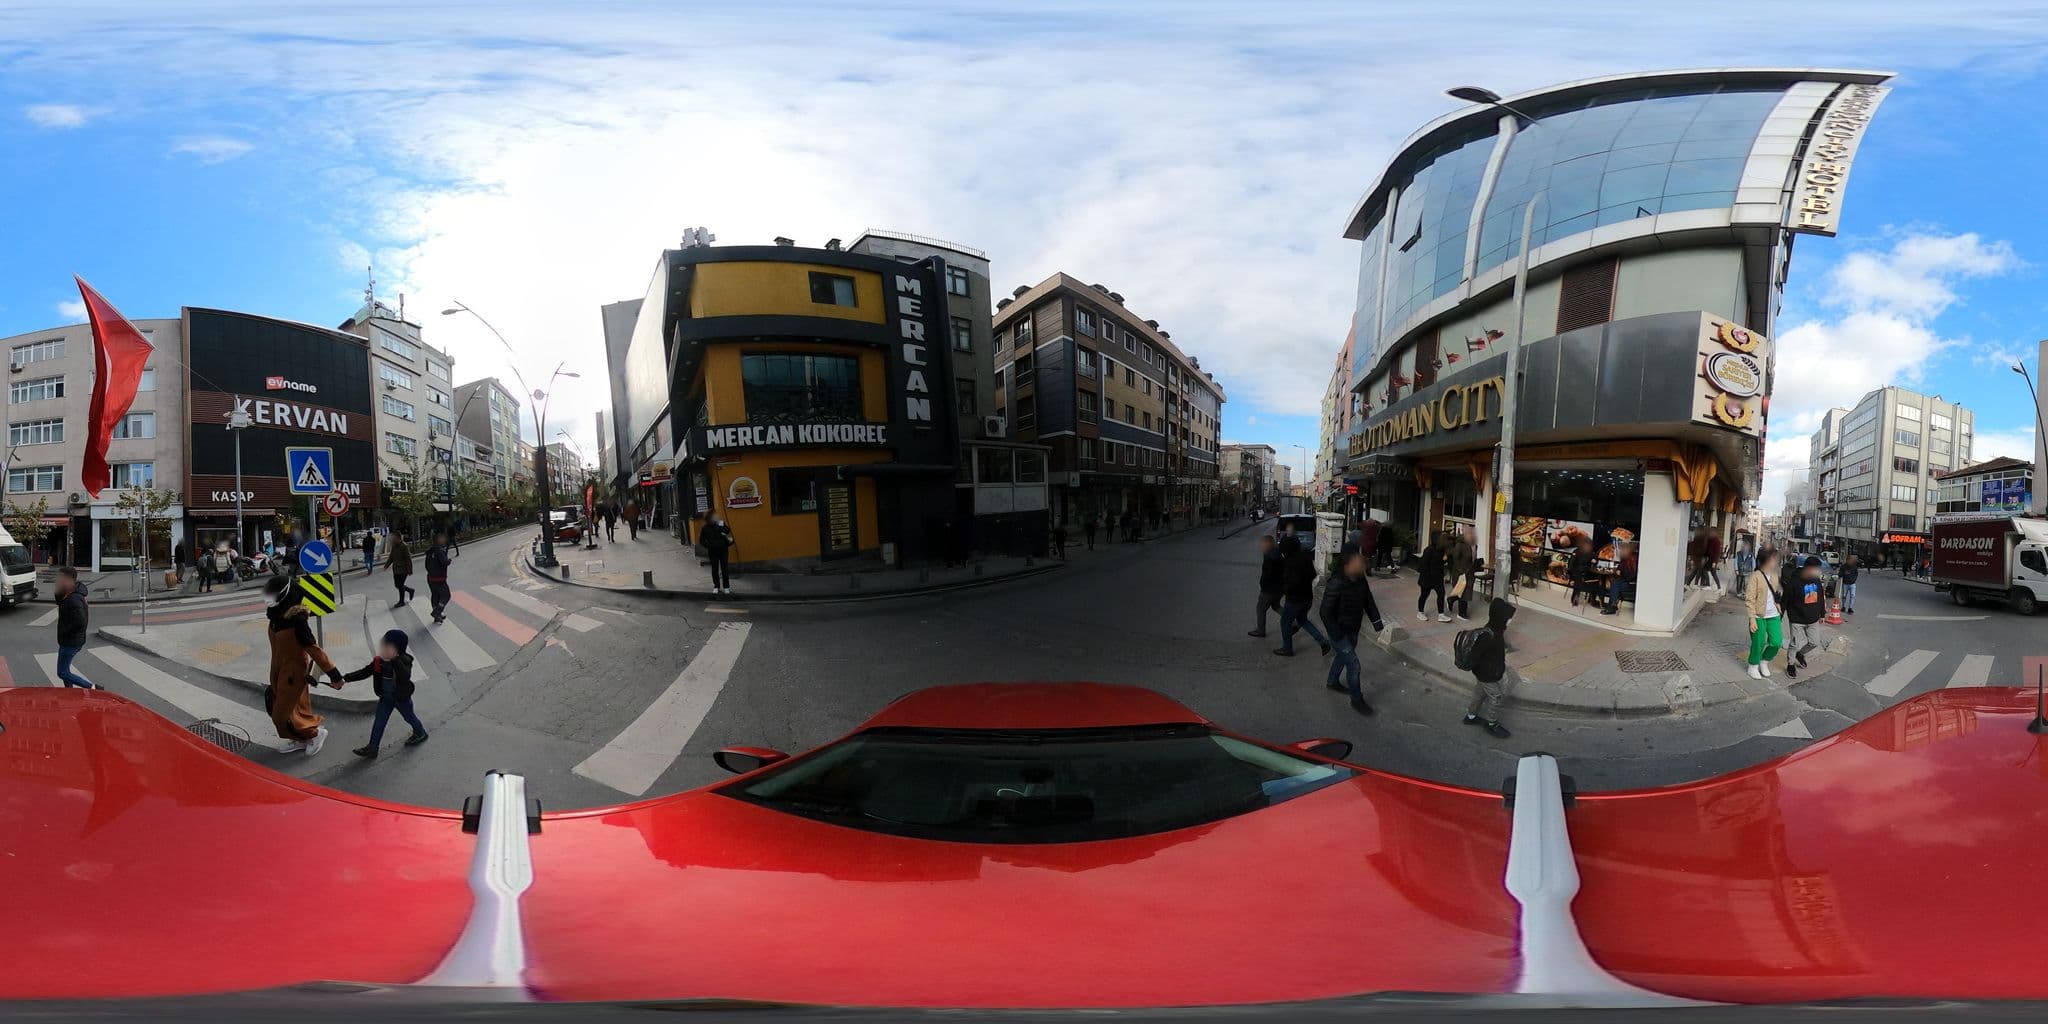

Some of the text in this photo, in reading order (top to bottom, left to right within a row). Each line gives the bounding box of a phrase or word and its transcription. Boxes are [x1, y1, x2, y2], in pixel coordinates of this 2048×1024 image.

[1798, 161, 1845, 229] HOTEL
[896, 274, 931, 422] MERCAN
[268, 377, 317, 394] evname
[234, 398, 348, 435] KERVAN
[1347, 432, 1364, 457] THE
[1363, 399, 1435, 452] OTTOMAN
[706, 424, 887, 449] MERCAN KOKOREÇ
[212, 490, 255, 502] KASAP
[1890, 534, 1922, 543] SOFRAM
[1940, 537, 1995, 550] DARDASON
